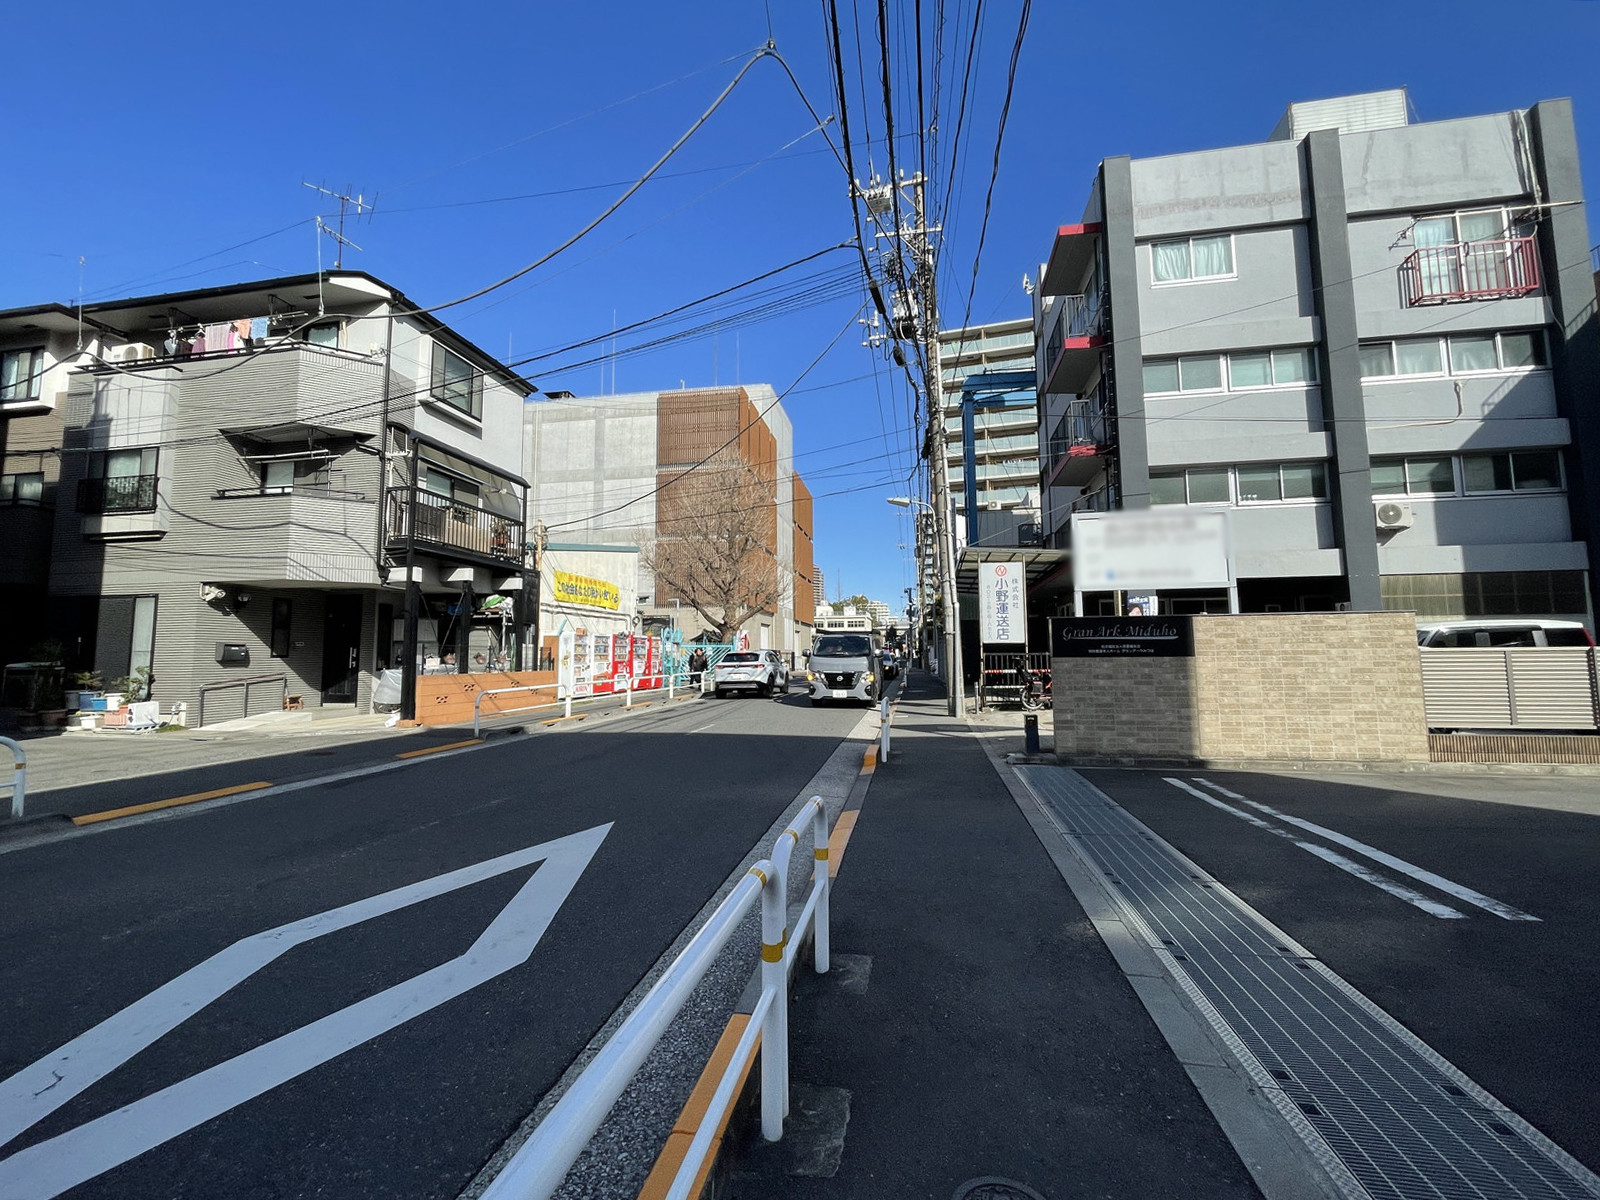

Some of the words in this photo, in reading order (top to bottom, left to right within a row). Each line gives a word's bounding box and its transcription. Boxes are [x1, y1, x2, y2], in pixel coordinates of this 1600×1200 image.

[1011, 578, 1019, 609] 株式会社
[995, 578, 1010, 641] 小野運送店
[1062, 626, 1093, 641] Gran
[1096, 624, 1122, 637] Ark
[1125, 623, 1177, 637] Miduho
